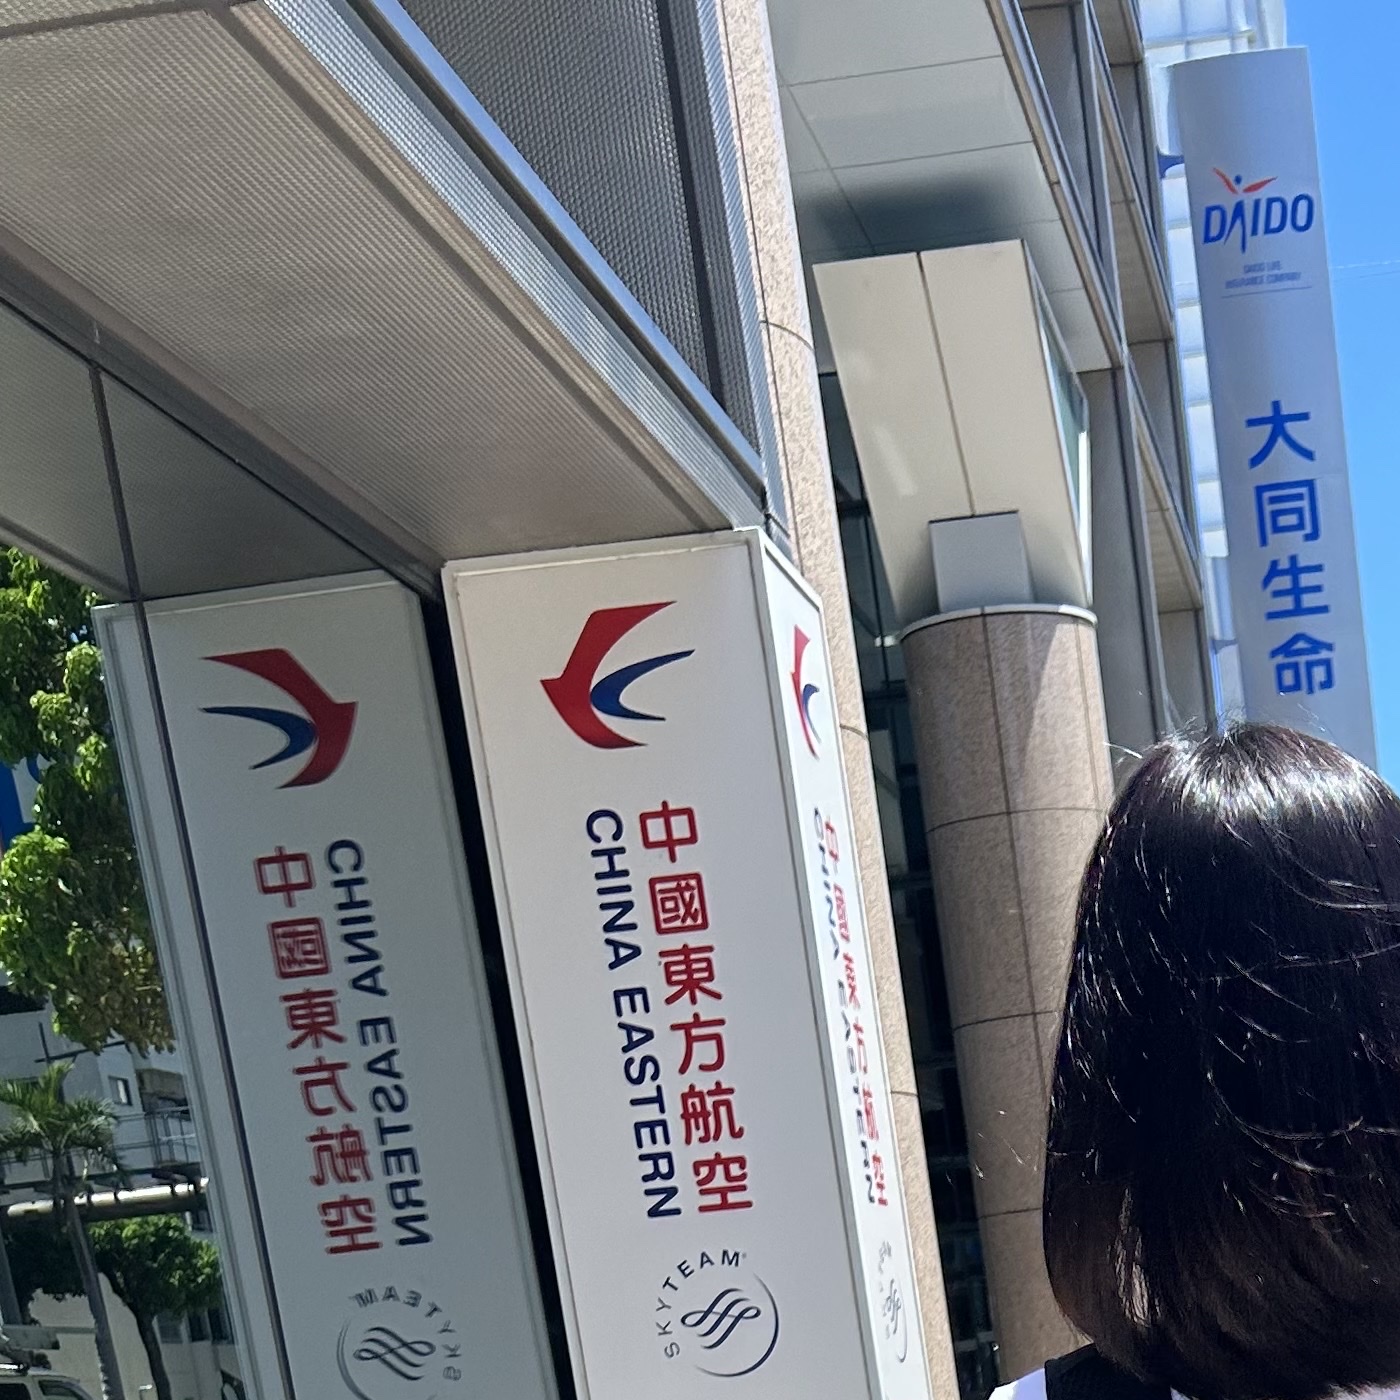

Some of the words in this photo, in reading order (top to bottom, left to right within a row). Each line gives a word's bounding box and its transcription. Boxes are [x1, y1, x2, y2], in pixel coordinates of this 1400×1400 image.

[1203, 193, 1314, 254] DAIDO
[1245, 400, 1335, 695] 大同生命
[585, 808, 643, 971] CHINA
[613, 985, 683, 1218] EASTERN
[639, 800, 754, 1214] 中國東方航空
